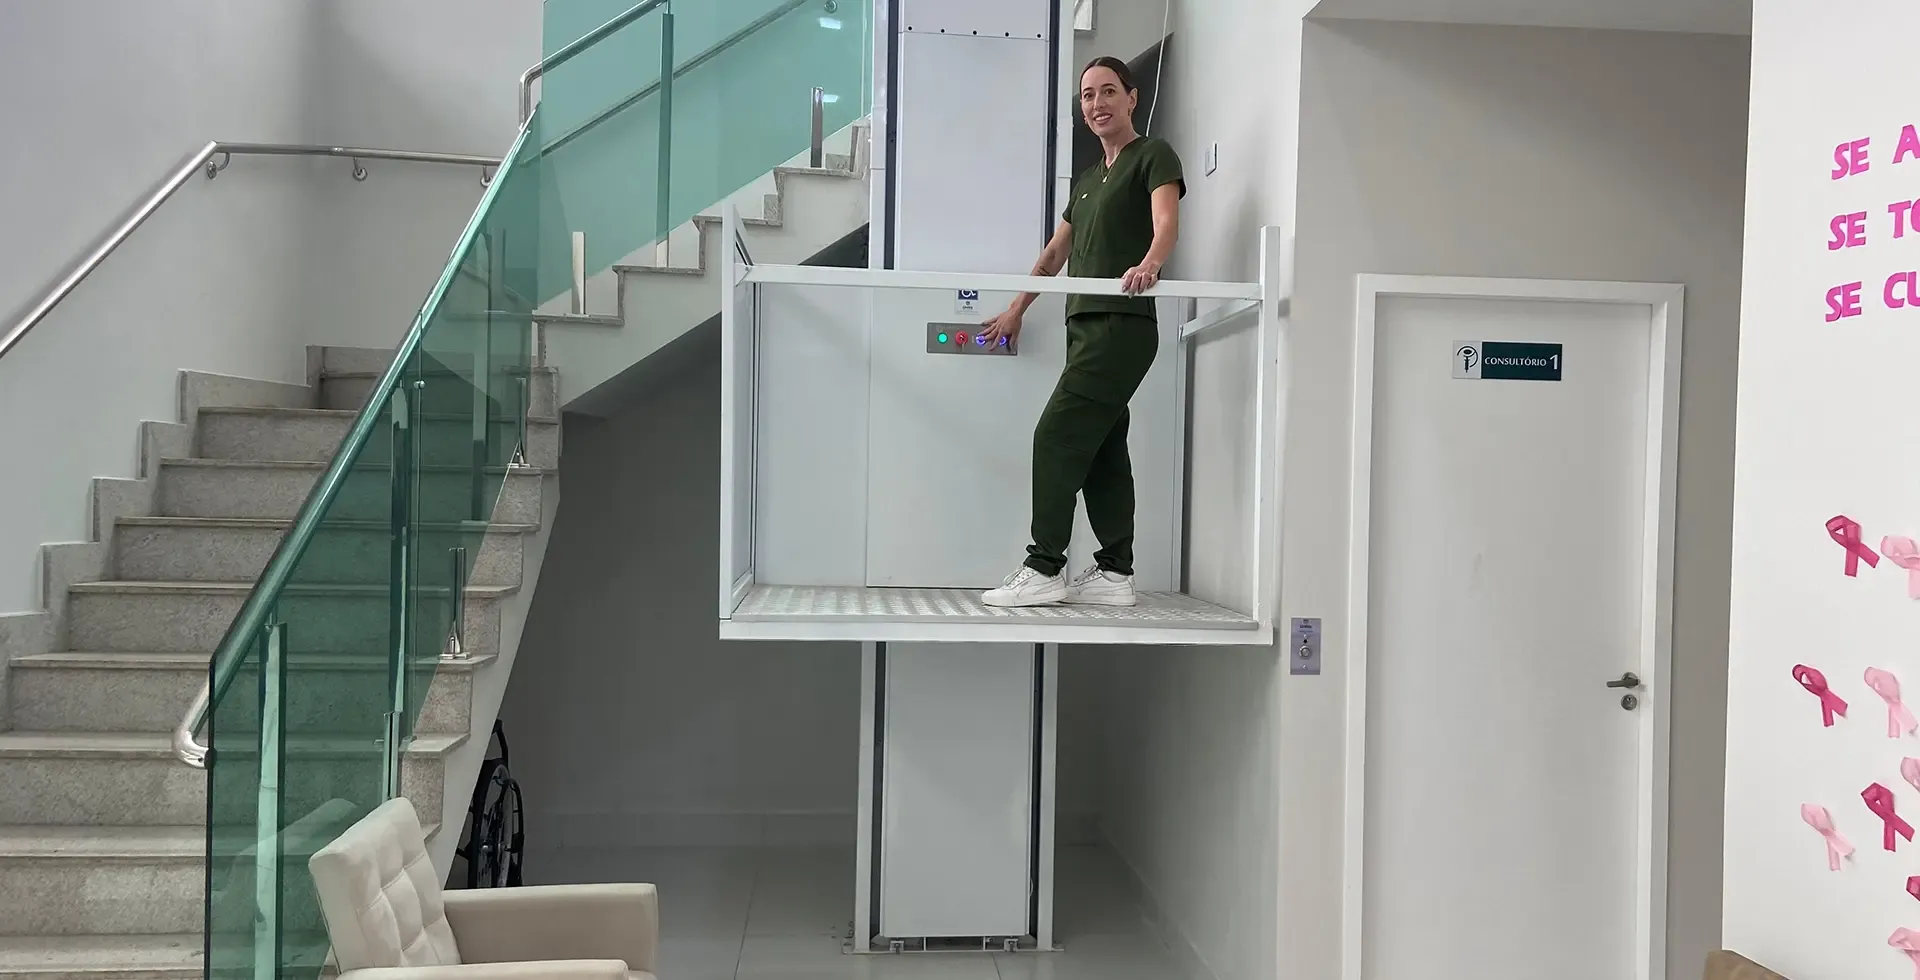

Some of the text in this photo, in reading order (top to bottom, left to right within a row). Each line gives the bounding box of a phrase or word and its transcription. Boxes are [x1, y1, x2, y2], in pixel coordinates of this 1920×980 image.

[1832, 137, 1870, 180] SE
[1828, 211, 1867, 251] SE
[1825, 281, 1862, 323] SE
[1484, 354, 1558, 370] CONSULTÓRIO 1
